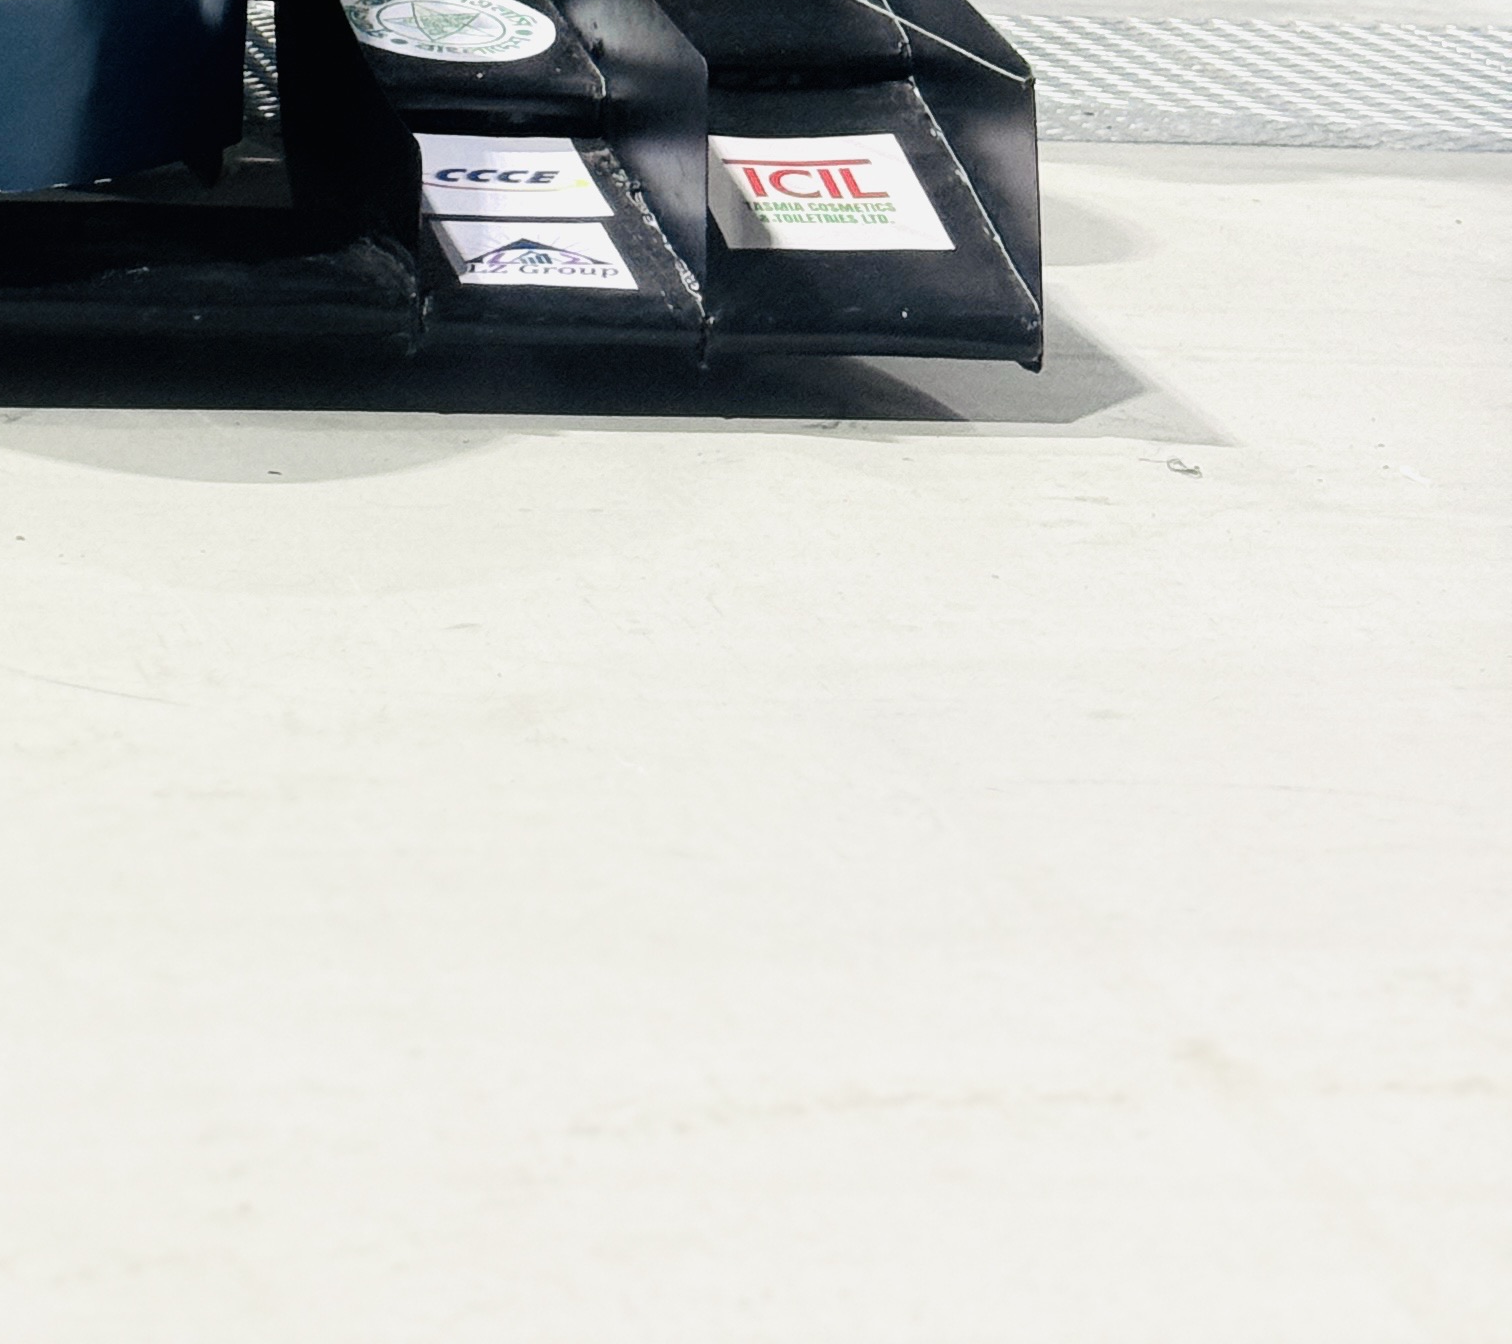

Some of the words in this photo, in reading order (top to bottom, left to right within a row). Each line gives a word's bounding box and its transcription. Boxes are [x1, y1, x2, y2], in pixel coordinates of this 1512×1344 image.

[434, 168, 560, 184] CCCE
[745, 201, 805, 212] TASMIA
[807, 202, 897, 213] COSMETICS
[774, 213, 859, 224] TOILETRIES
[861, 214, 896, 224] LTD.
[466, 263, 509, 274] LZ
[518, 264, 620, 279] Group
